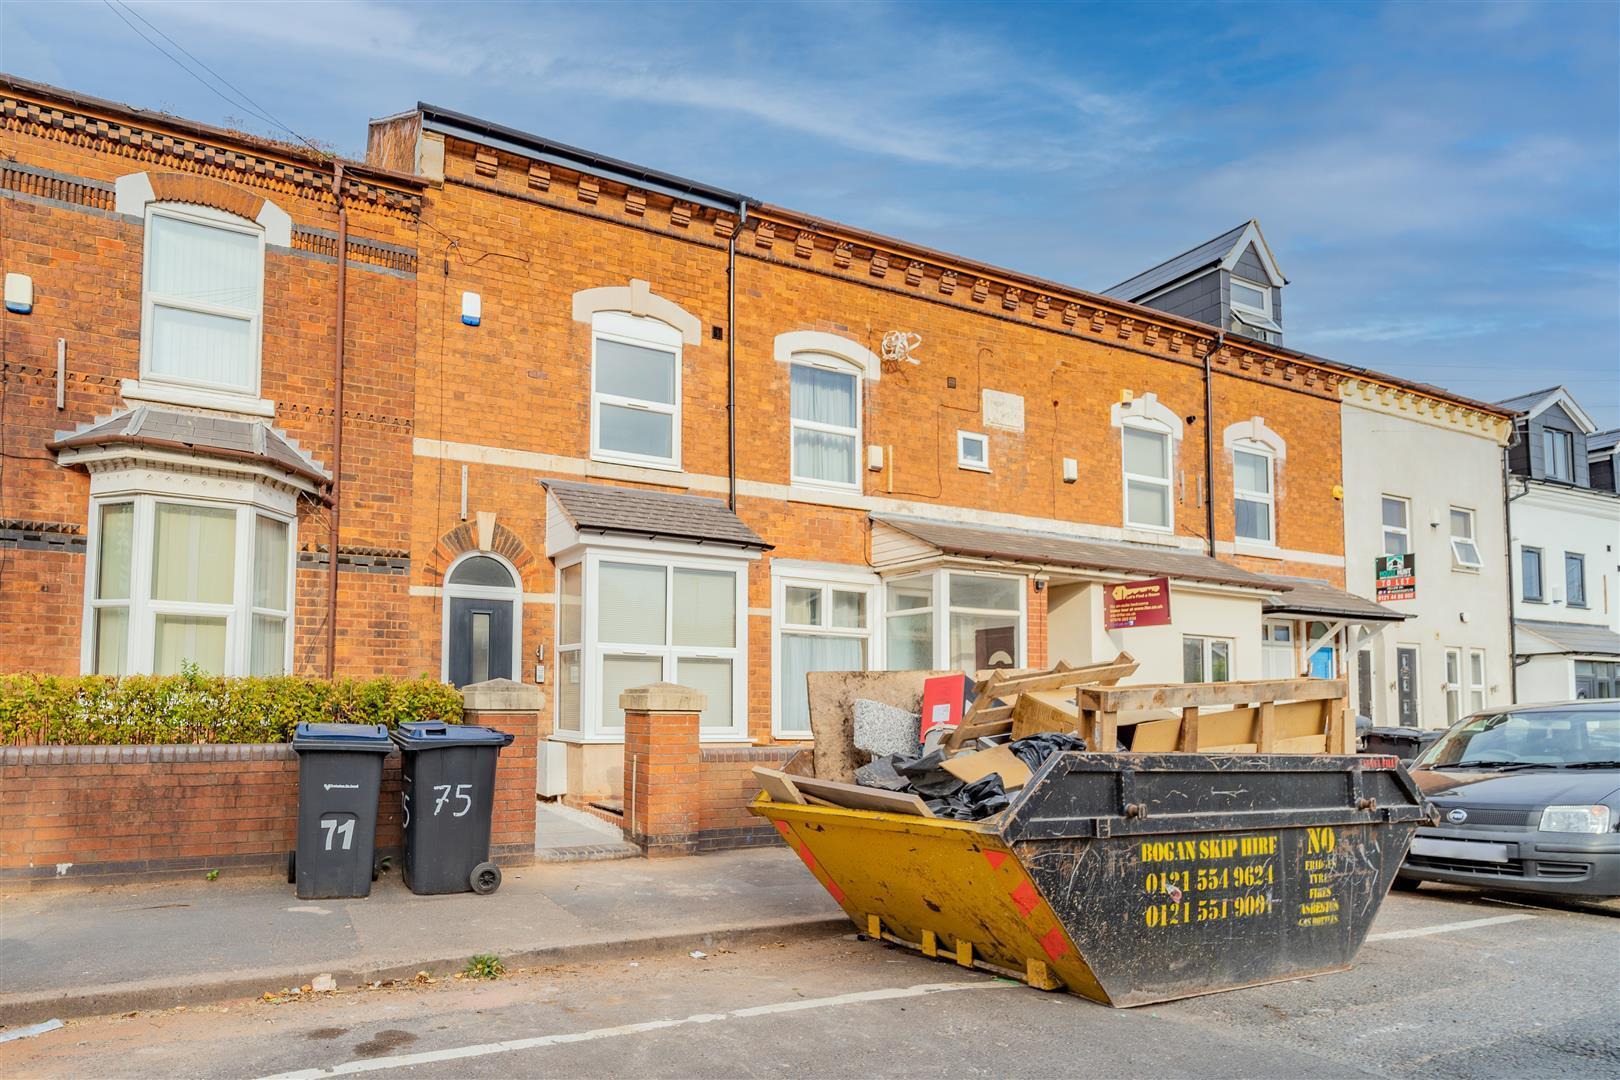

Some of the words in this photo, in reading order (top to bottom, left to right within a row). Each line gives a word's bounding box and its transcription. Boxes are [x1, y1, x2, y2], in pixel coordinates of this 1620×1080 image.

[1396, 577, 1410, 586] LET
[433, 784, 473, 817] 75
[320, 819, 356, 850] 71
[1306, 828, 1335, 854] NO
[1141, 841, 1197, 862] BOGAN
[1199, 838, 1238, 860] SKIP
[1240, 836, 1278, 856] HIRE
[1145, 870, 1190, 894] 0121
[1197, 868, 1229, 891] 554
[1233, 864, 1274, 888] 9624
[1145, 901, 1190, 928] 0121
